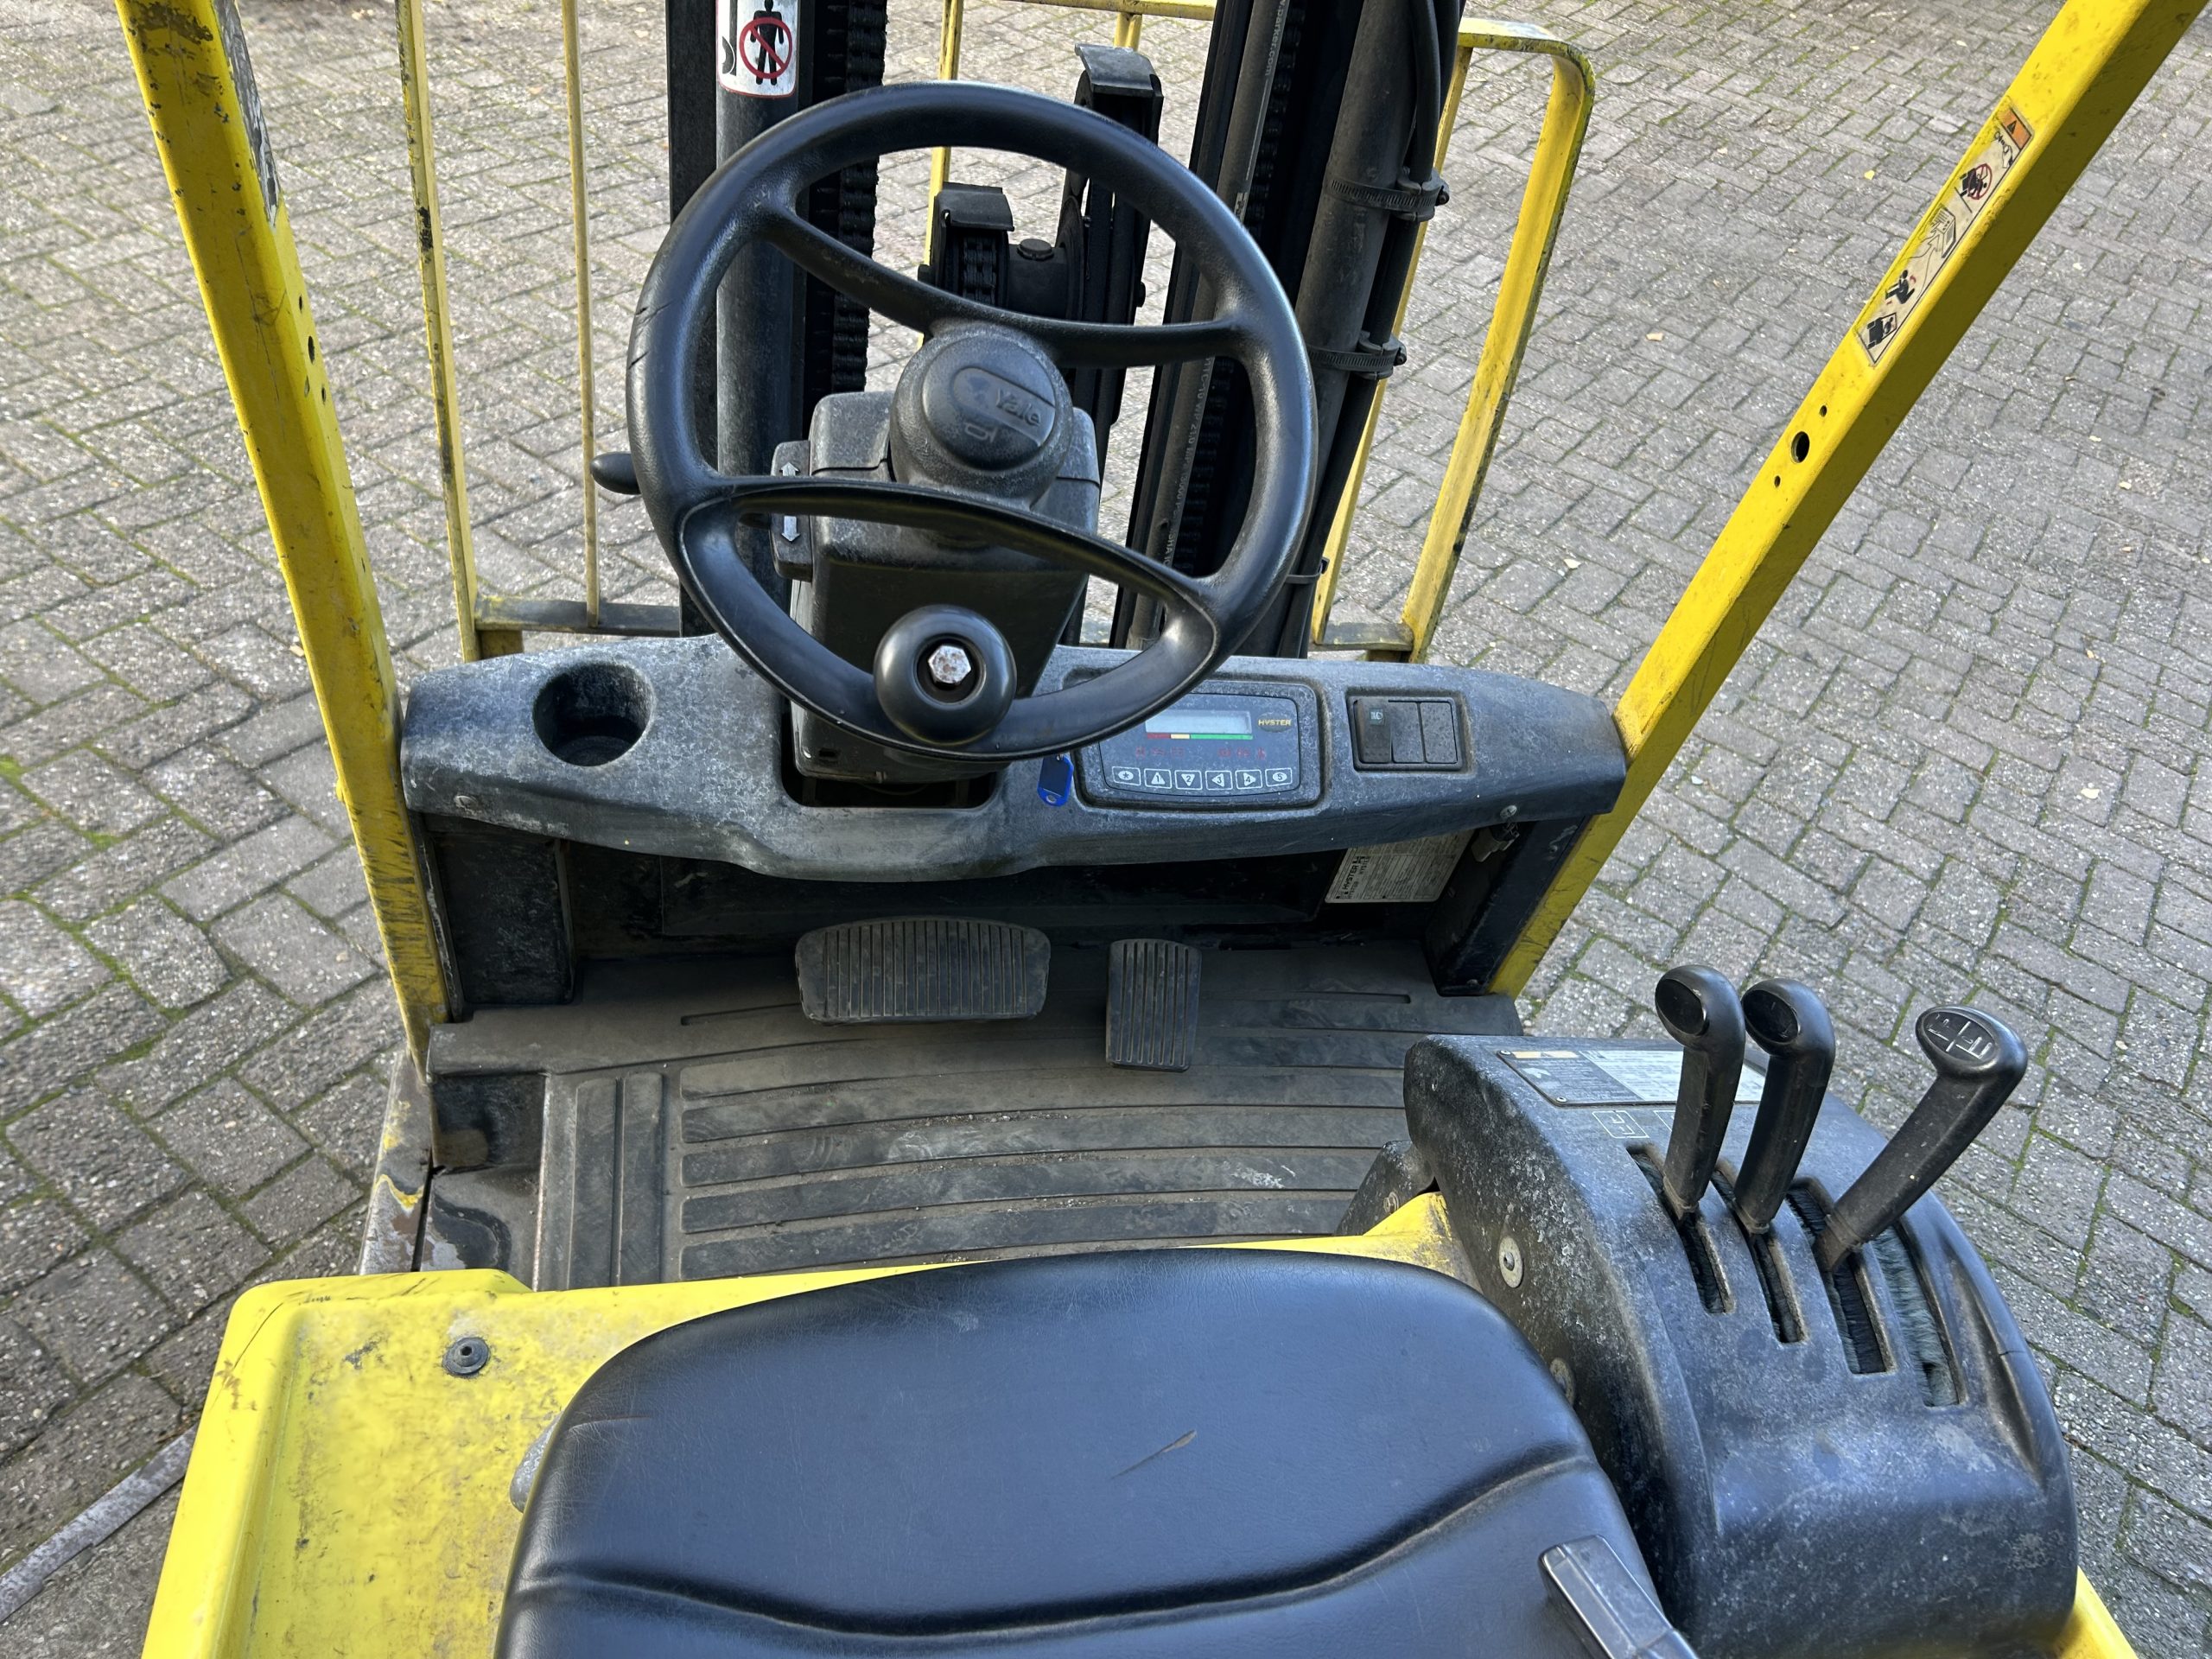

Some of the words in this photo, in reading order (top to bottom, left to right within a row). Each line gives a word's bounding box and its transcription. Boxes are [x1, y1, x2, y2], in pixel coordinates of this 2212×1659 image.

[996, 387, 1041, 427] Yale
[1258, 718, 1293, 727] HYSTER
[1342, 865, 1359, 890] HYSTER
